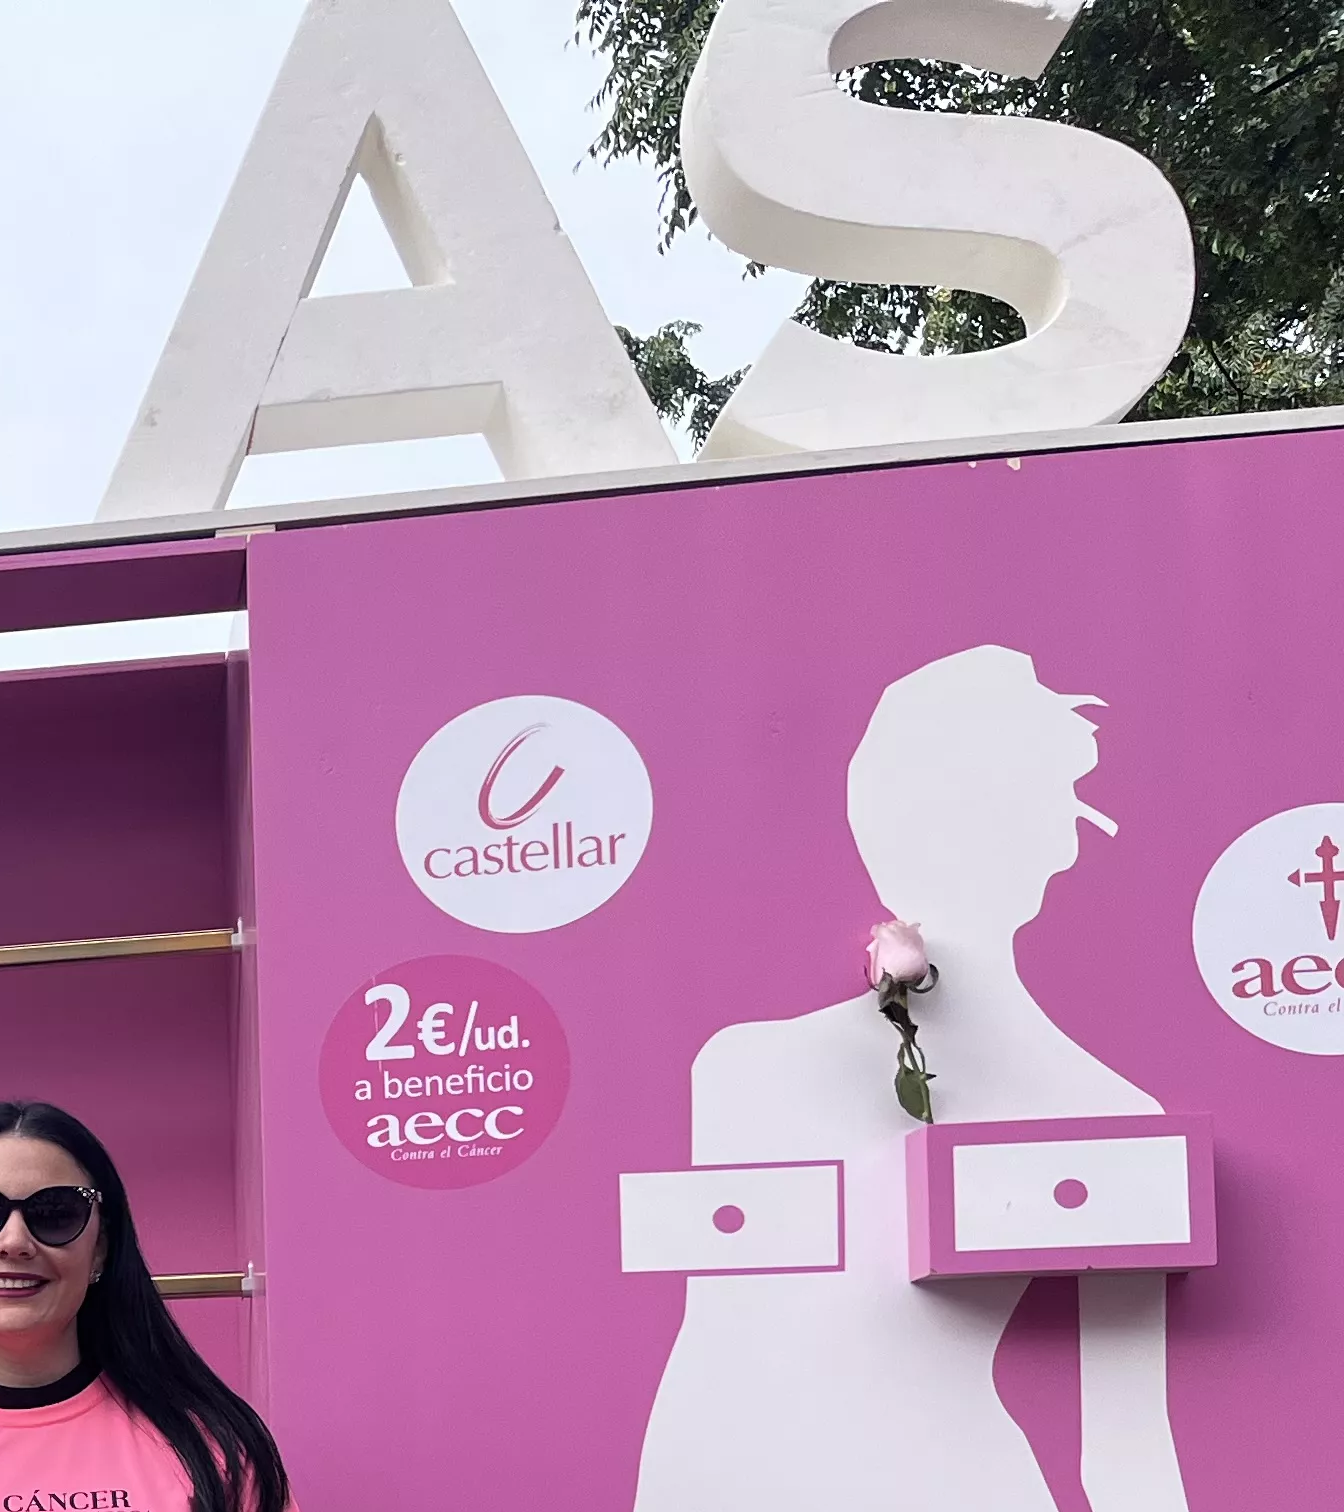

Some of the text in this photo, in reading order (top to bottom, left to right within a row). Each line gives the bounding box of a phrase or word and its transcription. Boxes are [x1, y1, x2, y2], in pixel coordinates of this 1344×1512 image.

[423, 821, 626, 879] castellar
[364, 983, 530, 1061] 2€/ud.
[1263, 998, 1341, 1017] Contra el
[354, 1063, 534, 1101] a beneficio
[366, 1105, 525, 1148] aecc
[390, 1143, 504, 1162] Contra el Cáncer
[3, 1489, 131, 1512] CÁNCER
